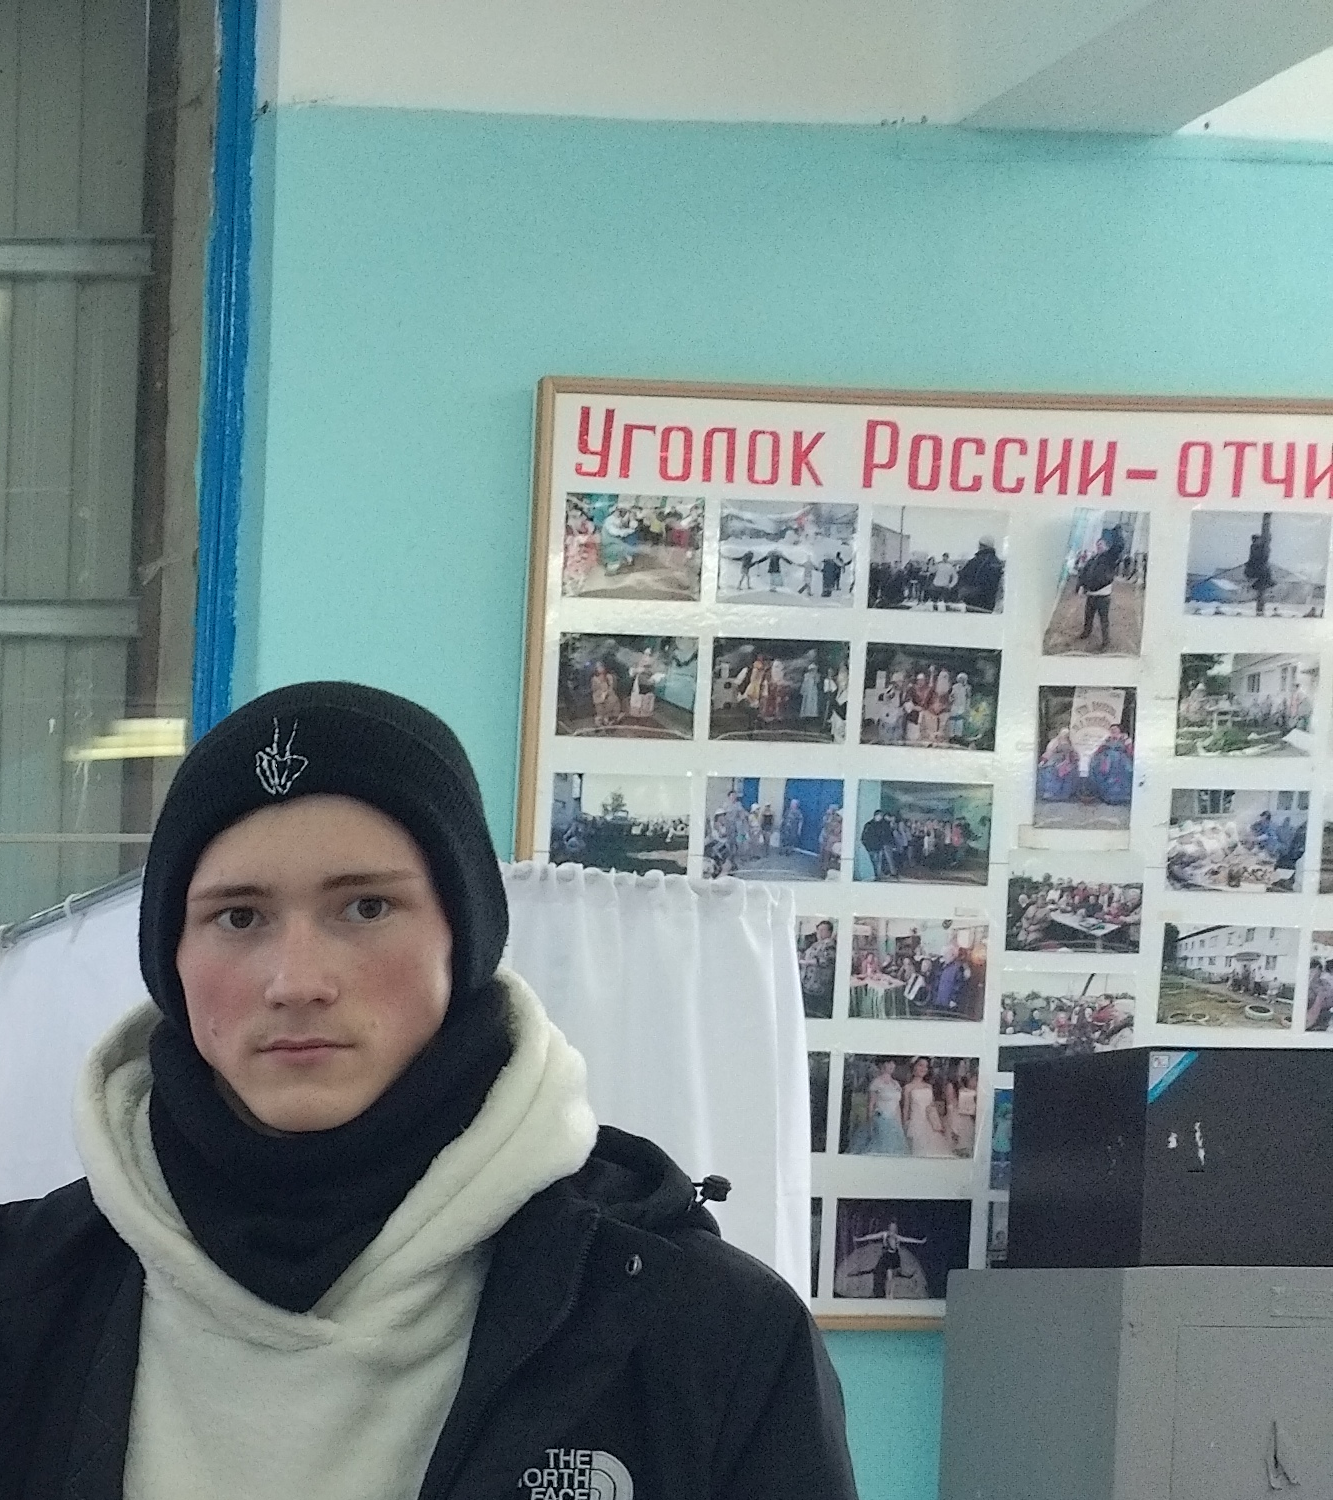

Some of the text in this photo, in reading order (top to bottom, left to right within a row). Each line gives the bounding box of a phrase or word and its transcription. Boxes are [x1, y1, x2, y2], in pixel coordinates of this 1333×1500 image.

[575, 406, 826, 486] Уголок
[544, 1448, 591, 1468] THE
[518, 1467, 590, 1488] ORTH
